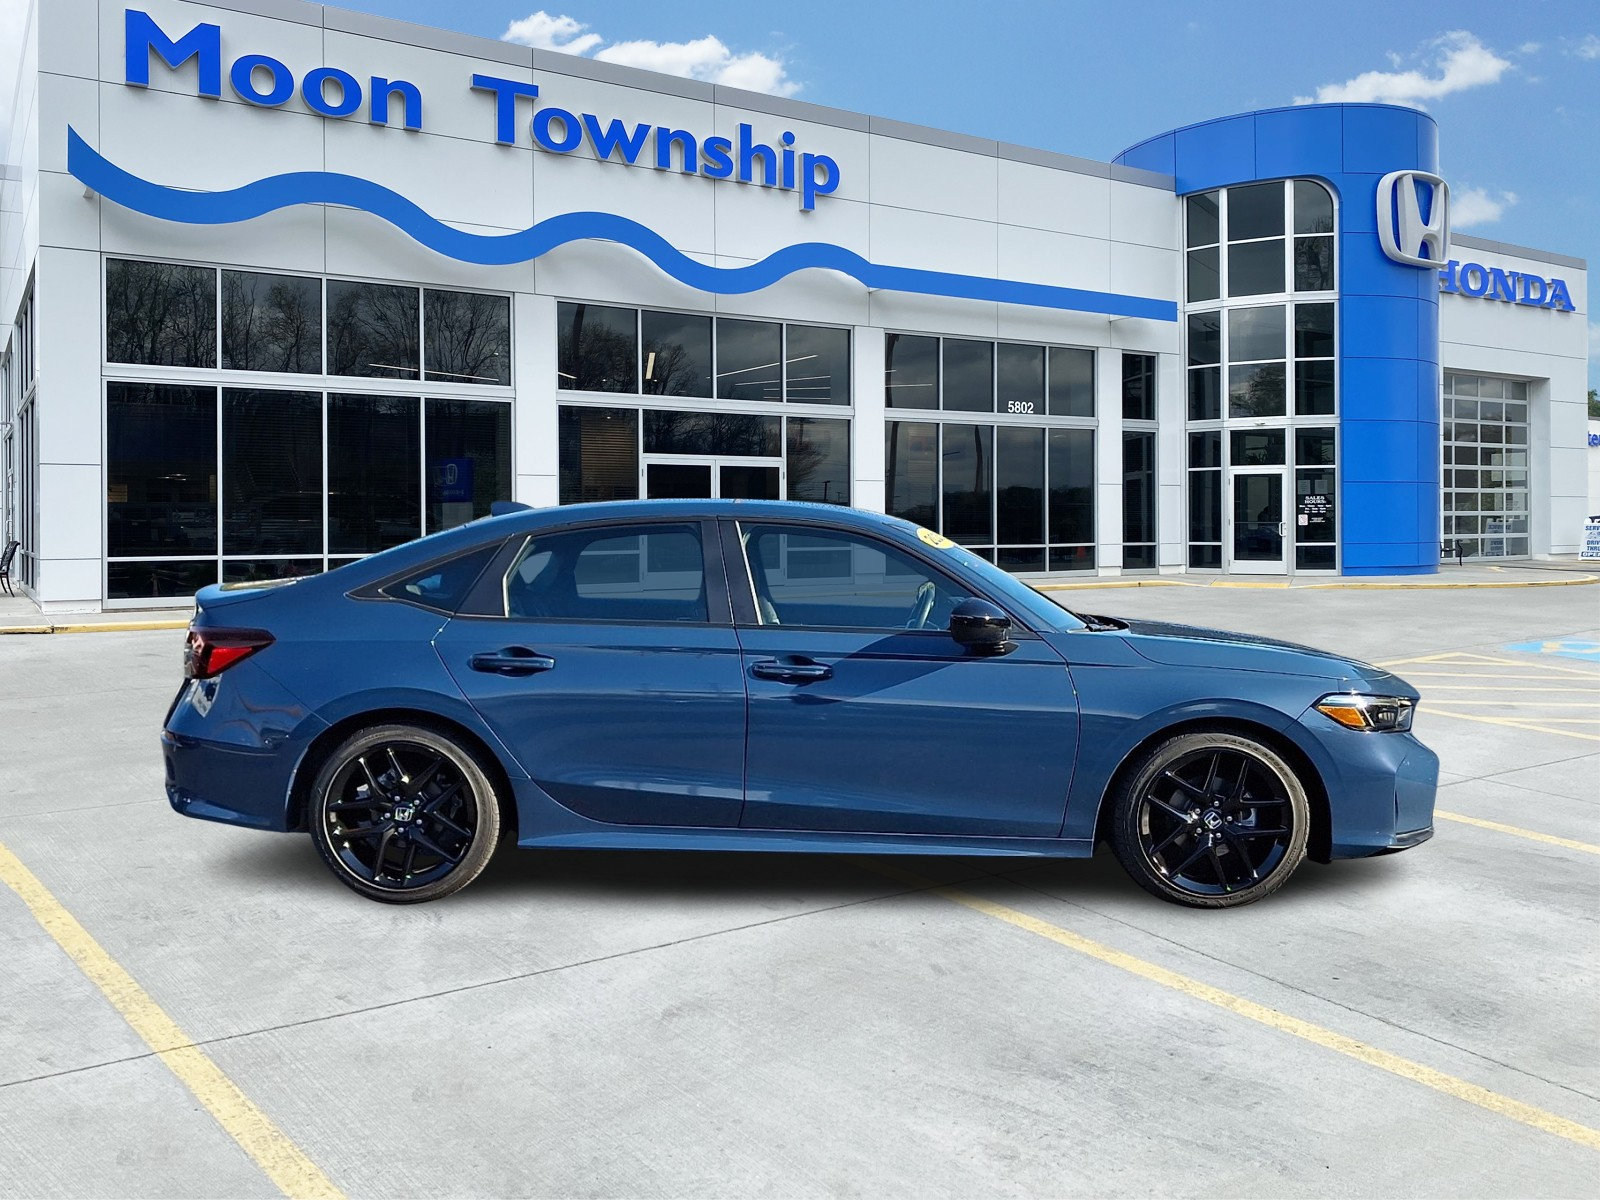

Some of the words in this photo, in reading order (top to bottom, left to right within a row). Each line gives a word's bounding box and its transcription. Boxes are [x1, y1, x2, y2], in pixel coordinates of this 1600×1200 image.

[125, 9, 422, 131] Moon
[469, 73, 841, 212] Township
[1439, 260, 1576, 311] HONDA
[1007, 400, 1034, 414] 5802
